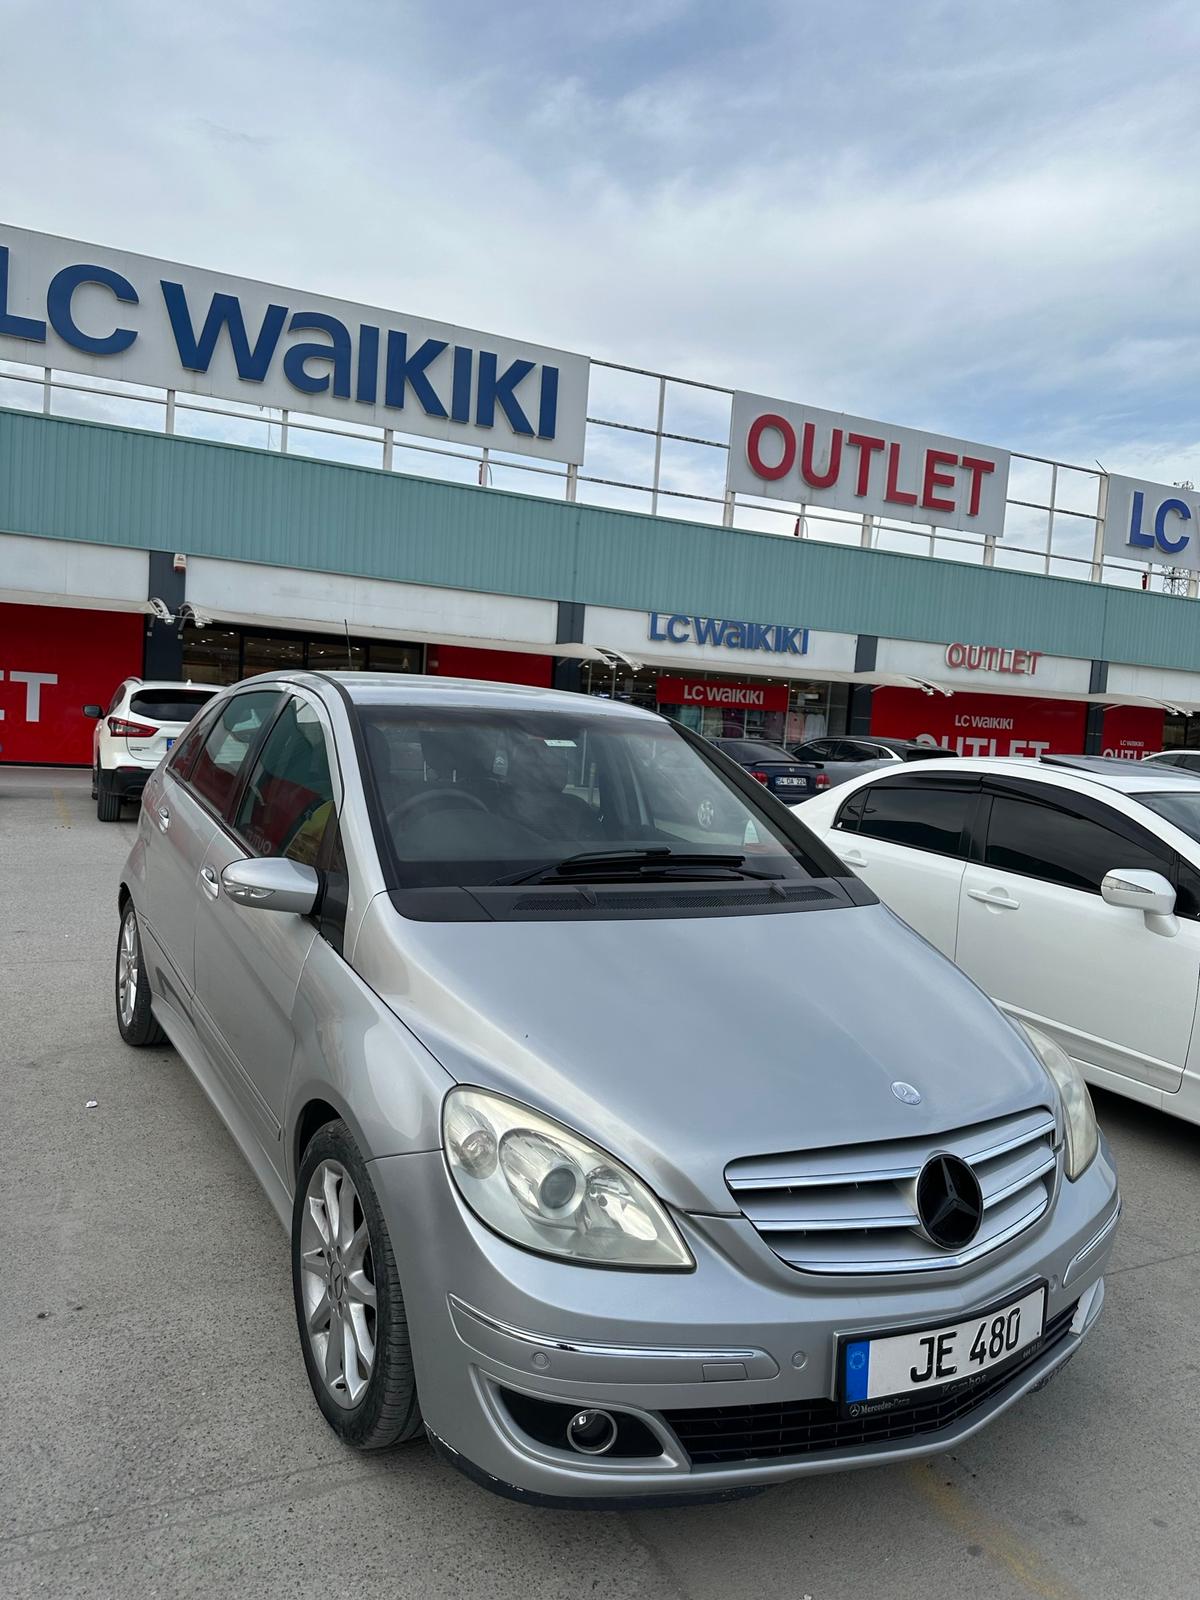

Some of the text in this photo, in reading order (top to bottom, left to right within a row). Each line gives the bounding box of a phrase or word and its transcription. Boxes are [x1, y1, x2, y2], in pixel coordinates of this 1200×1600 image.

[0, 246, 140, 355] LC
[747, 414, 995, 516] OUTLET
[1127, 491, 1191, 554] LC
[649, 612, 690, 643] LC
[946, 643, 1044, 675] OUTLET
[0, 669, 58, 722] T
[683, 684, 704, 700] LC
[955, 714, 969, 727] LC
[910, 1307, 1021, 1383] JE 480
